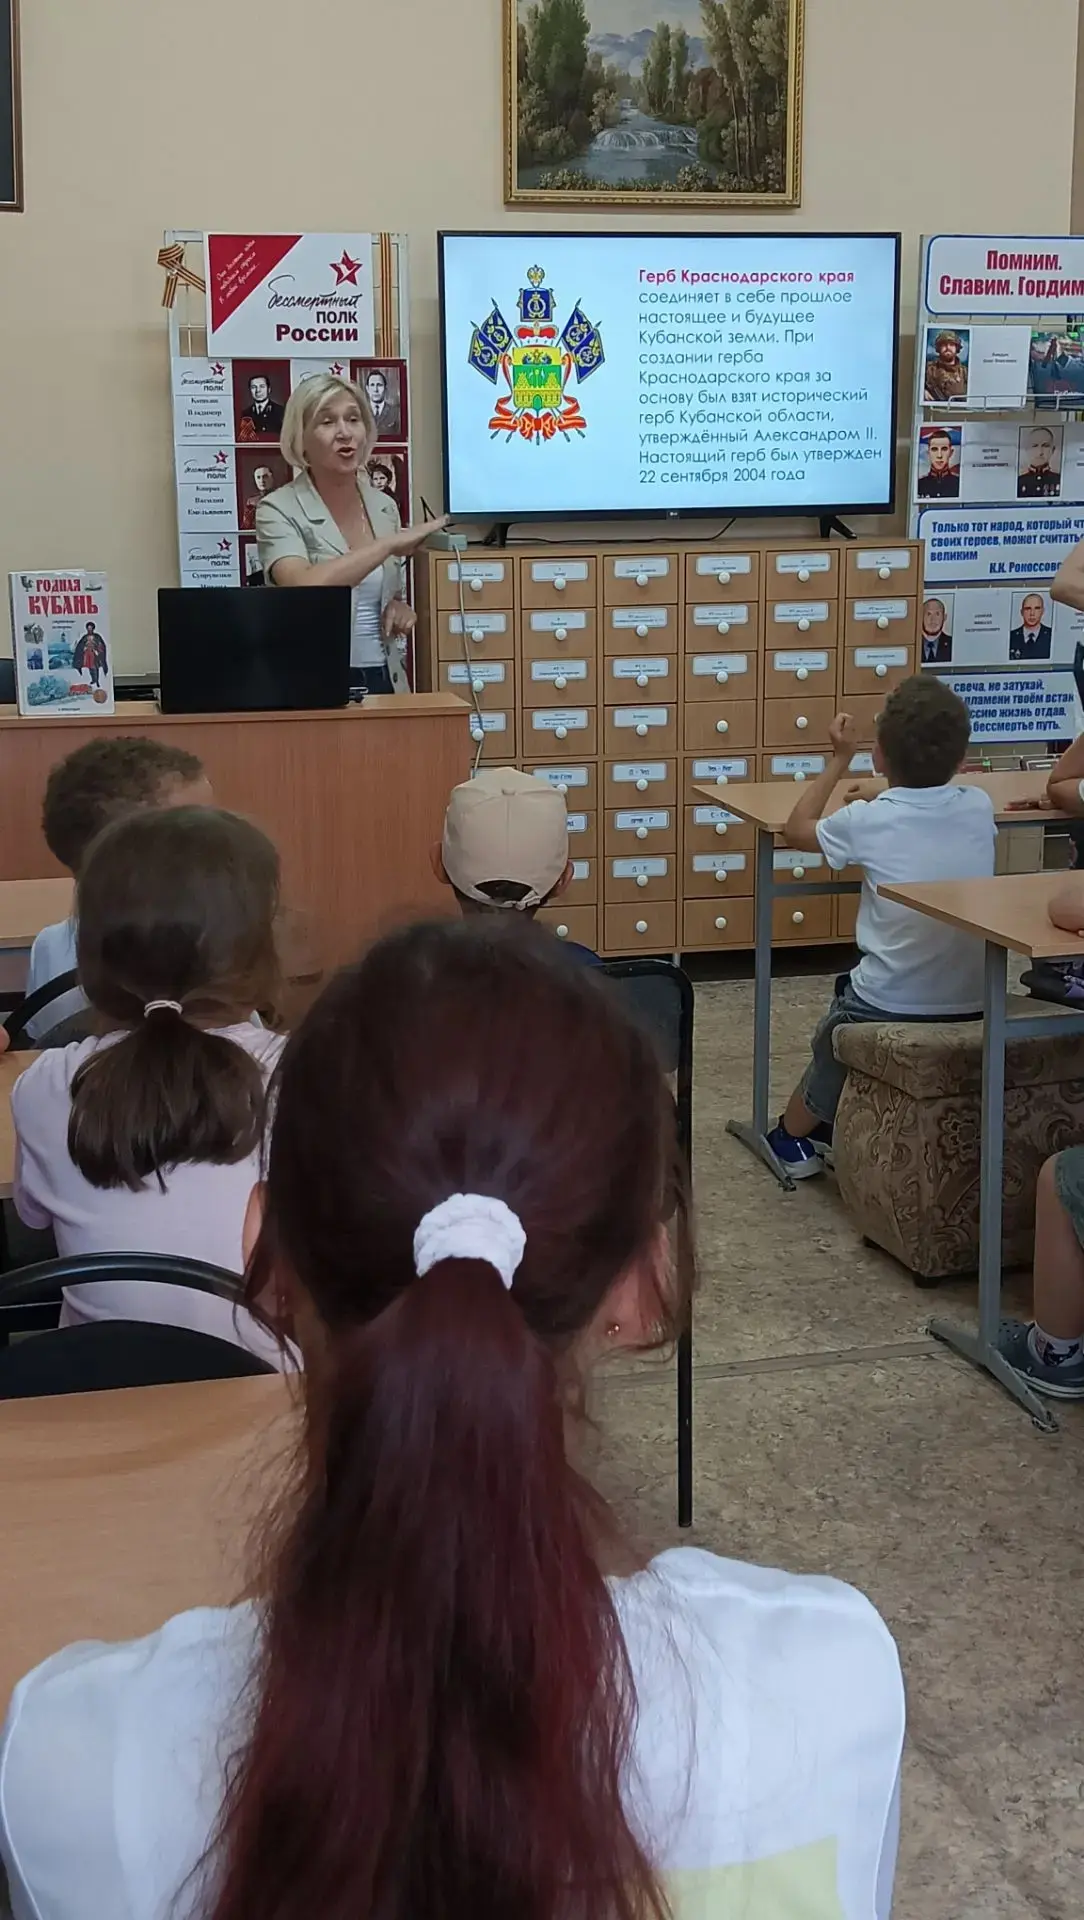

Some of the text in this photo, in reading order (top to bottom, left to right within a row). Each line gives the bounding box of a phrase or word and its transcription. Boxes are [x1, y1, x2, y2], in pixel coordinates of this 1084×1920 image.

[987, 250, 1062, 270] Помним.
[639, 269, 854, 285] Герб Краснодарского края
[940, 275, 1084, 298] Славим. Гордим
[639, 290, 852, 305] соединяет в себе прошлое
[639, 310, 814, 325] настоящее и будущее
[275, 323, 358, 342] России
[639, 330, 814, 345] Кубанской земли. При
[639, 350, 763, 365] создании герба
[639, 371, 831, 385] Краснодарского края за
[639, 389, 868, 405] основу был взят исторический
[639, 409, 834, 426] герб Кубанской области,
[639, 427, 877, 446] утверждённый Александром II.
[639, 448, 882, 463] Настоящий герб был утвержден
[639, 469, 805, 484] 22 сентября 2004 года
[932, 522, 969, 532] Только
[972, 522, 988, 532] тот
[990, 521, 1024, 532] народ,
[1026, 518, 1072, 530] который
[931, 537, 962, 547] своих
[964, 535, 1000, 546] героев,
[1002, 535, 1037, 545] может
[930, 551, 978, 561] великим
[36, 579, 81, 592] РОДНАЯ
[28, 595, 99, 617] КУБАНЬ
[954, 683, 986, 692] свеча,
[988, 682, 1001, 691] не
[964, 692, 1074, 705] пламени твоём встан
[970, 707, 1066, 718] ссию жизнь отдав,
[973, 720, 1061, 732] бессмертье путь.
